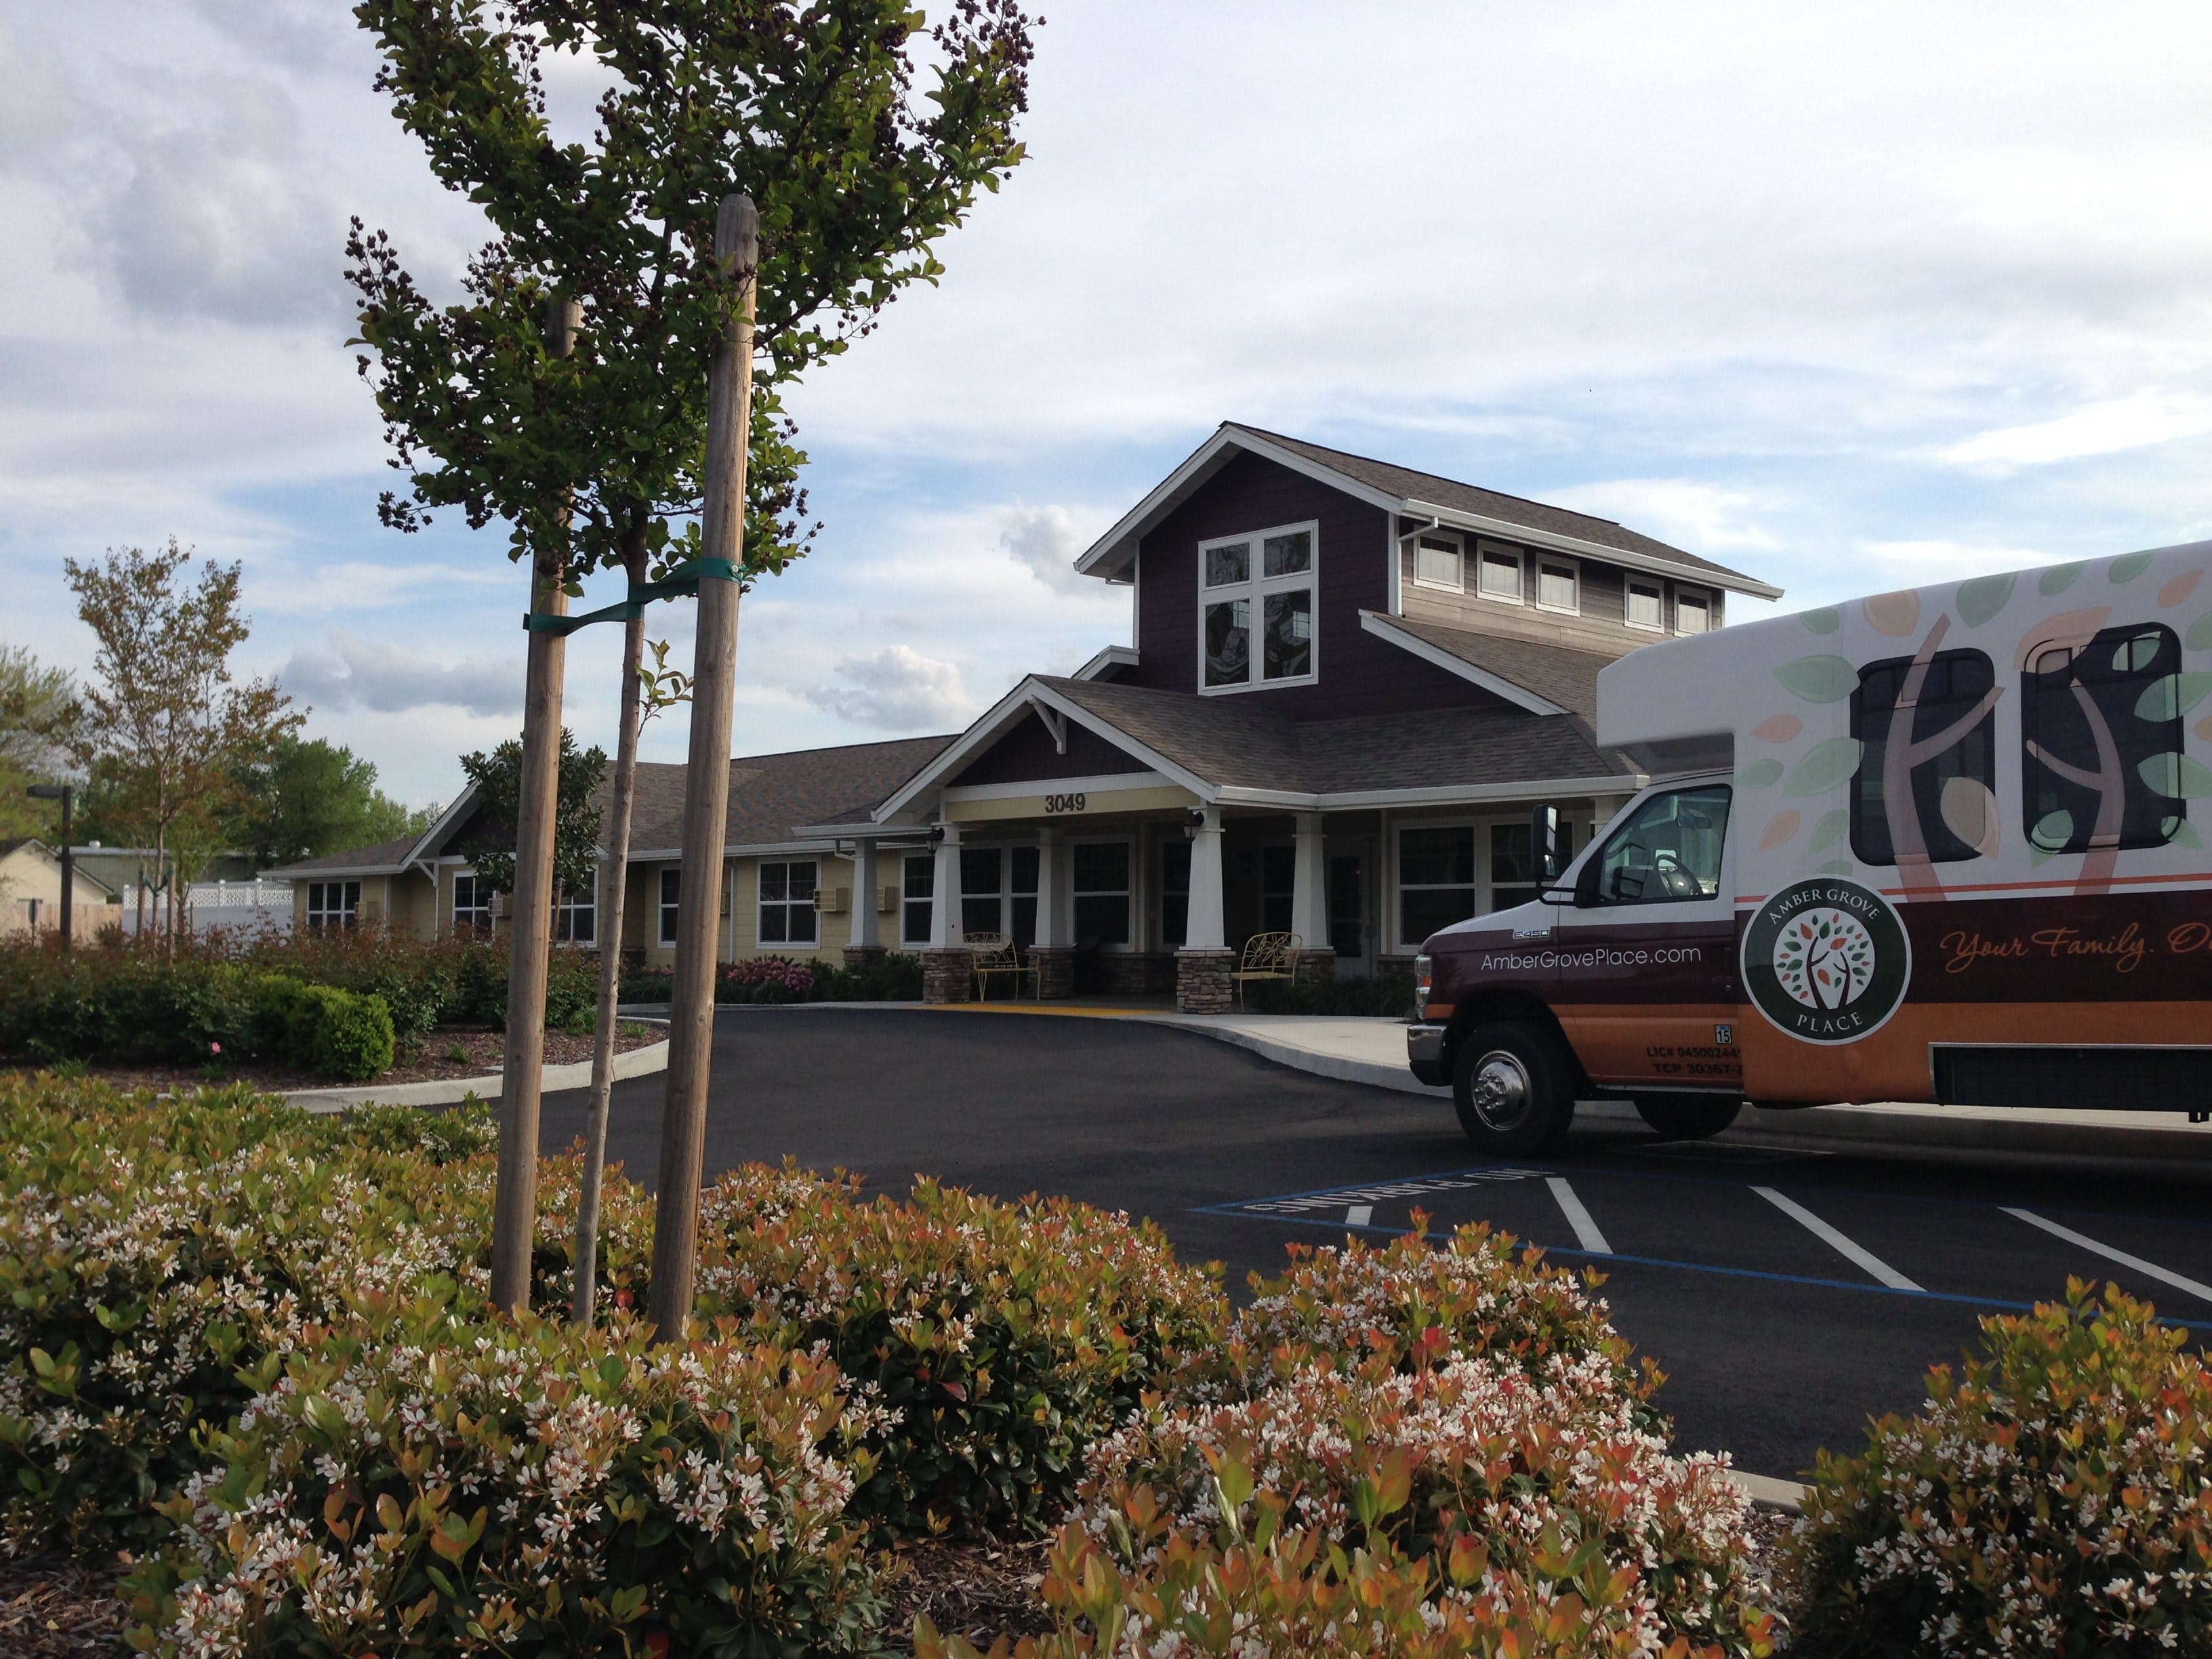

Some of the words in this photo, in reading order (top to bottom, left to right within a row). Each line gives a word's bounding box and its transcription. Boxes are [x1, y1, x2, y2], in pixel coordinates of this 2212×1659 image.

[1045, 793, 1086, 813] 3049
[1769, 888, 1822, 925] AMBER
[1827, 888, 1881, 920] GROVE
[1480, 947, 1702, 970] AmberGrovePlace.com
[1940, 930, 2028, 974] Your
[2031, 922, 2154, 973] Family.
[2168, 922, 2212, 954] O
[1797, 1012, 1862, 1033] PLACE
[1718, 1030, 1730, 1042] 15
[1654, 1063, 1681, 1073] TCP
[1243, 1179, 1479, 1212] PARKING
